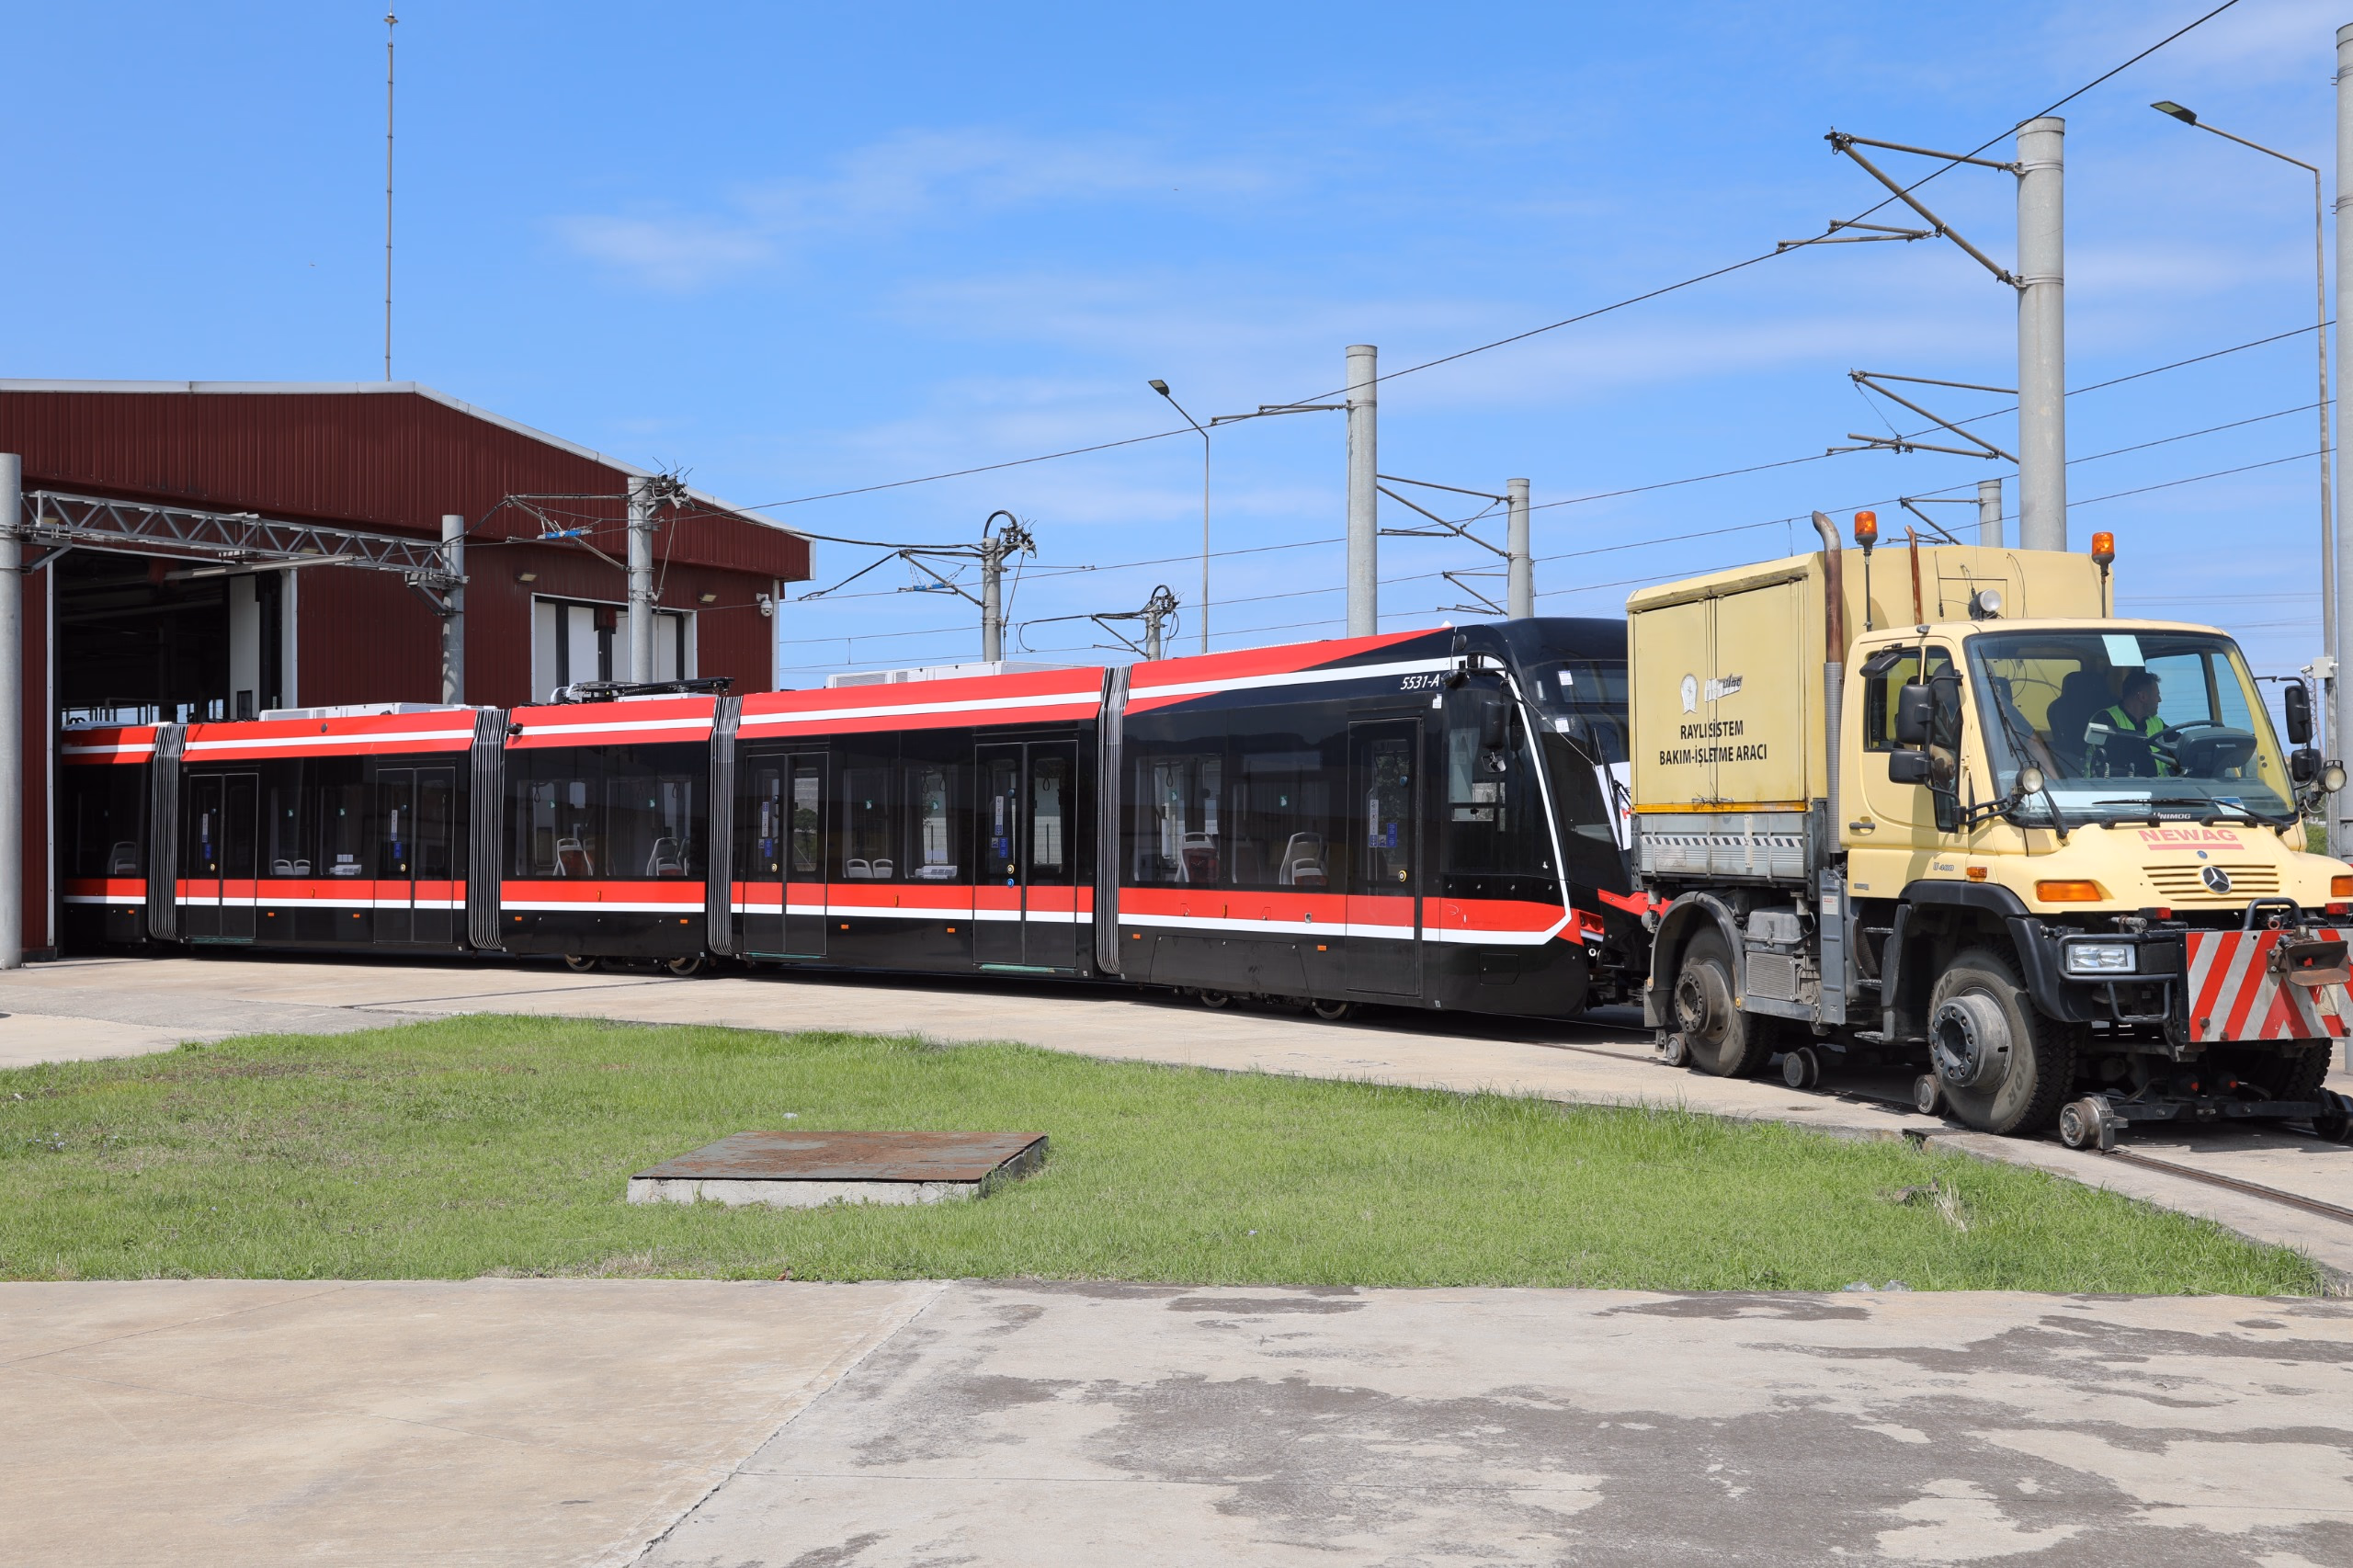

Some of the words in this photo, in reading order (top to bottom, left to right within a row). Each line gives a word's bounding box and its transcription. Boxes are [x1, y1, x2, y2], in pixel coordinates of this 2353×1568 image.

[1400, 674, 1440, 690] 5531-A
[1680, 723, 1708, 740] RAYLI
[1709, 719, 1744, 738] SİSTEM
[1736, 744, 1768, 761] ARACI
[2137, 829, 2239, 842] NEWAG
